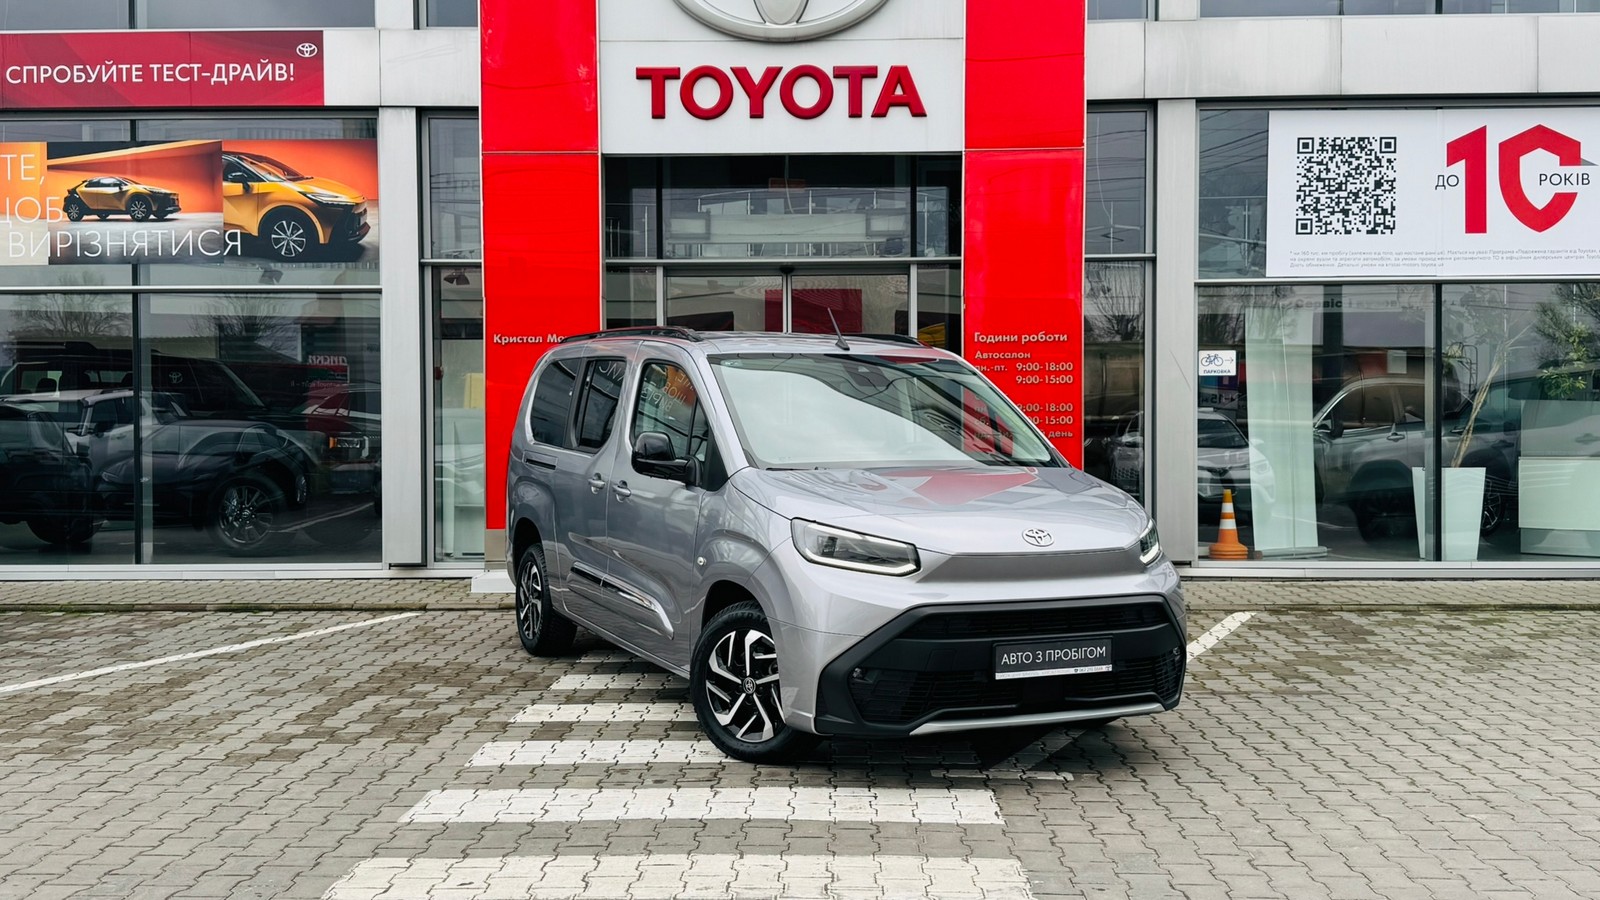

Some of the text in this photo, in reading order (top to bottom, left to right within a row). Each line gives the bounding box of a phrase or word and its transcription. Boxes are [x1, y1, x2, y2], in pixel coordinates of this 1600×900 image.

[5, 59, 295, 86] СПРОБУЙТЕ ТЕСТ-ДРАЙВ!
[636, 64, 927, 120] TOYOTA
[1435, 124, 1591, 234] ДО 10 РОКІВ
[9, 229, 242, 258] ВИРІЗНЯТИСЯ
[493, 333, 543, 345] Кристал
[974, 331, 1068, 344] Години роботи
[974, 350, 1031, 359] Автосалон
[1016, 362, 1074, 371] 9:00-18:00
[1016, 375, 1074, 384] 9:00-15:00
[1048, 430, 1073, 438] день
[1001, 646, 1106, 665] АВТО З ПРОБІГОМ
